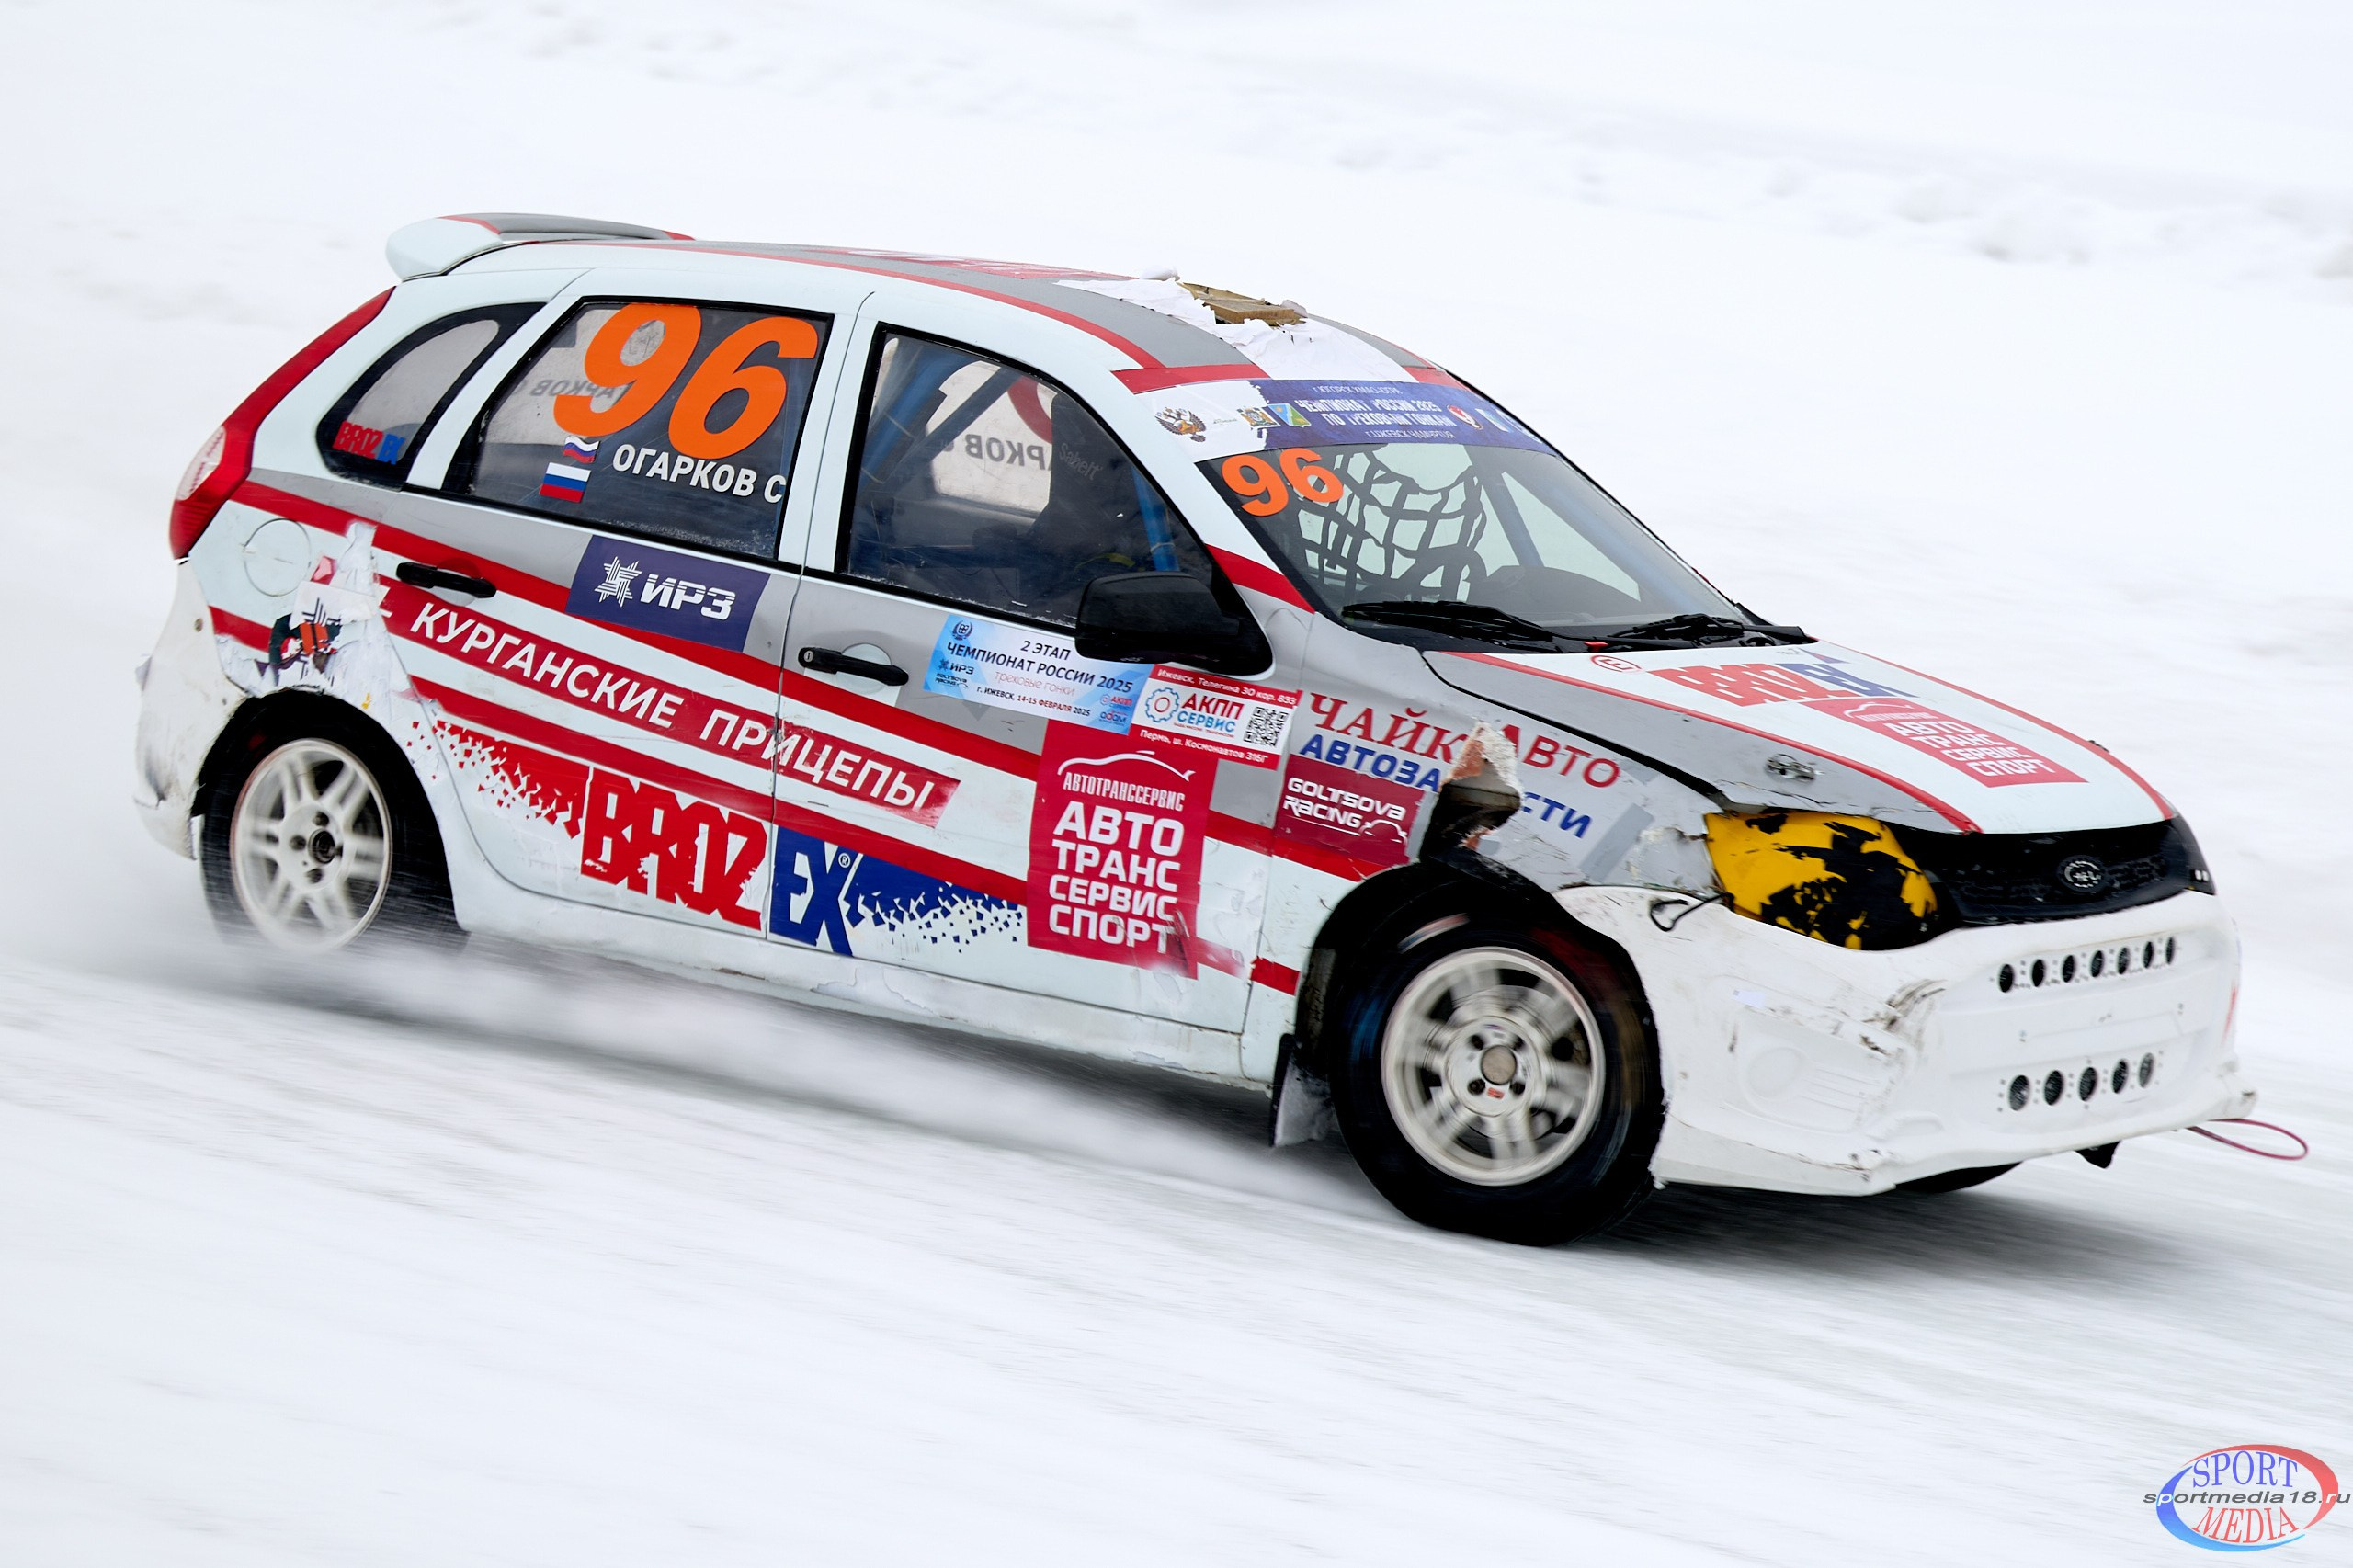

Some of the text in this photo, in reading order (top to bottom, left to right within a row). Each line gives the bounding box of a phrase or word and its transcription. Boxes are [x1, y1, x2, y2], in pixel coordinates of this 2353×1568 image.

[553, 302, 818, 460] 96
[1294, 399, 1443, 413] ЧЕМПИОНАТ РОССИИ 2025
[1320, 413, 1458, 427] ПО ТРЕКОВЫМ ГОНКАМ
[613, 443, 787, 504] ОГАРКОВ С
[1221, 447, 1345, 517] 96
[641, 573, 736, 621] ИРЗ
[1020, 640, 1071, 661] 2 ЭТАП
[947, 642, 1133, 693] ЧЕМПИОНАТ РОССИИ 2025
[949, 663, 975, 676] ИРЗ
[976, 686, 1091, 717] г. ИЖЕВСК, 14-15 ФЕВРАЛЯ 2025
[1043, 680, 1075, 697] гонки
[1198, 677, 1241, 694] Телегина
[1242, 687, 1256, 697] 30
[1277, 695, 1297, 706] 853
[410, 602, 936, 811] КУРГАНСКИЕ ПРИЦЕПЫ
[1177, 710, 1236, 733] СЕРВИС
[1181, 693, 1245, 720] АКПП
[1310, 692, 1470, 764] ЧАЙК
[1883, 721, 1977, 736] АВТО
[1908, 733, 2007, 749] ТРАНС
[1140, 729, 1172, 744] Пермь,
[1184, 738, 1245, 759] Космонавтов
[1940, 746, 2032, 762] СЕРВИС
[1966, 759, 2056, 777] СПОРТ
[1063, 771, 1186, 812] АВТОТРАНССЕРВИС
[1053, 800, 1185, 857] АВТО
[1051, 838, 1181, 892] ТРАНС
[1049, 874, 1178, 921] СЕРВИС
[1049, 903, 1176, 954] СПОРТ
